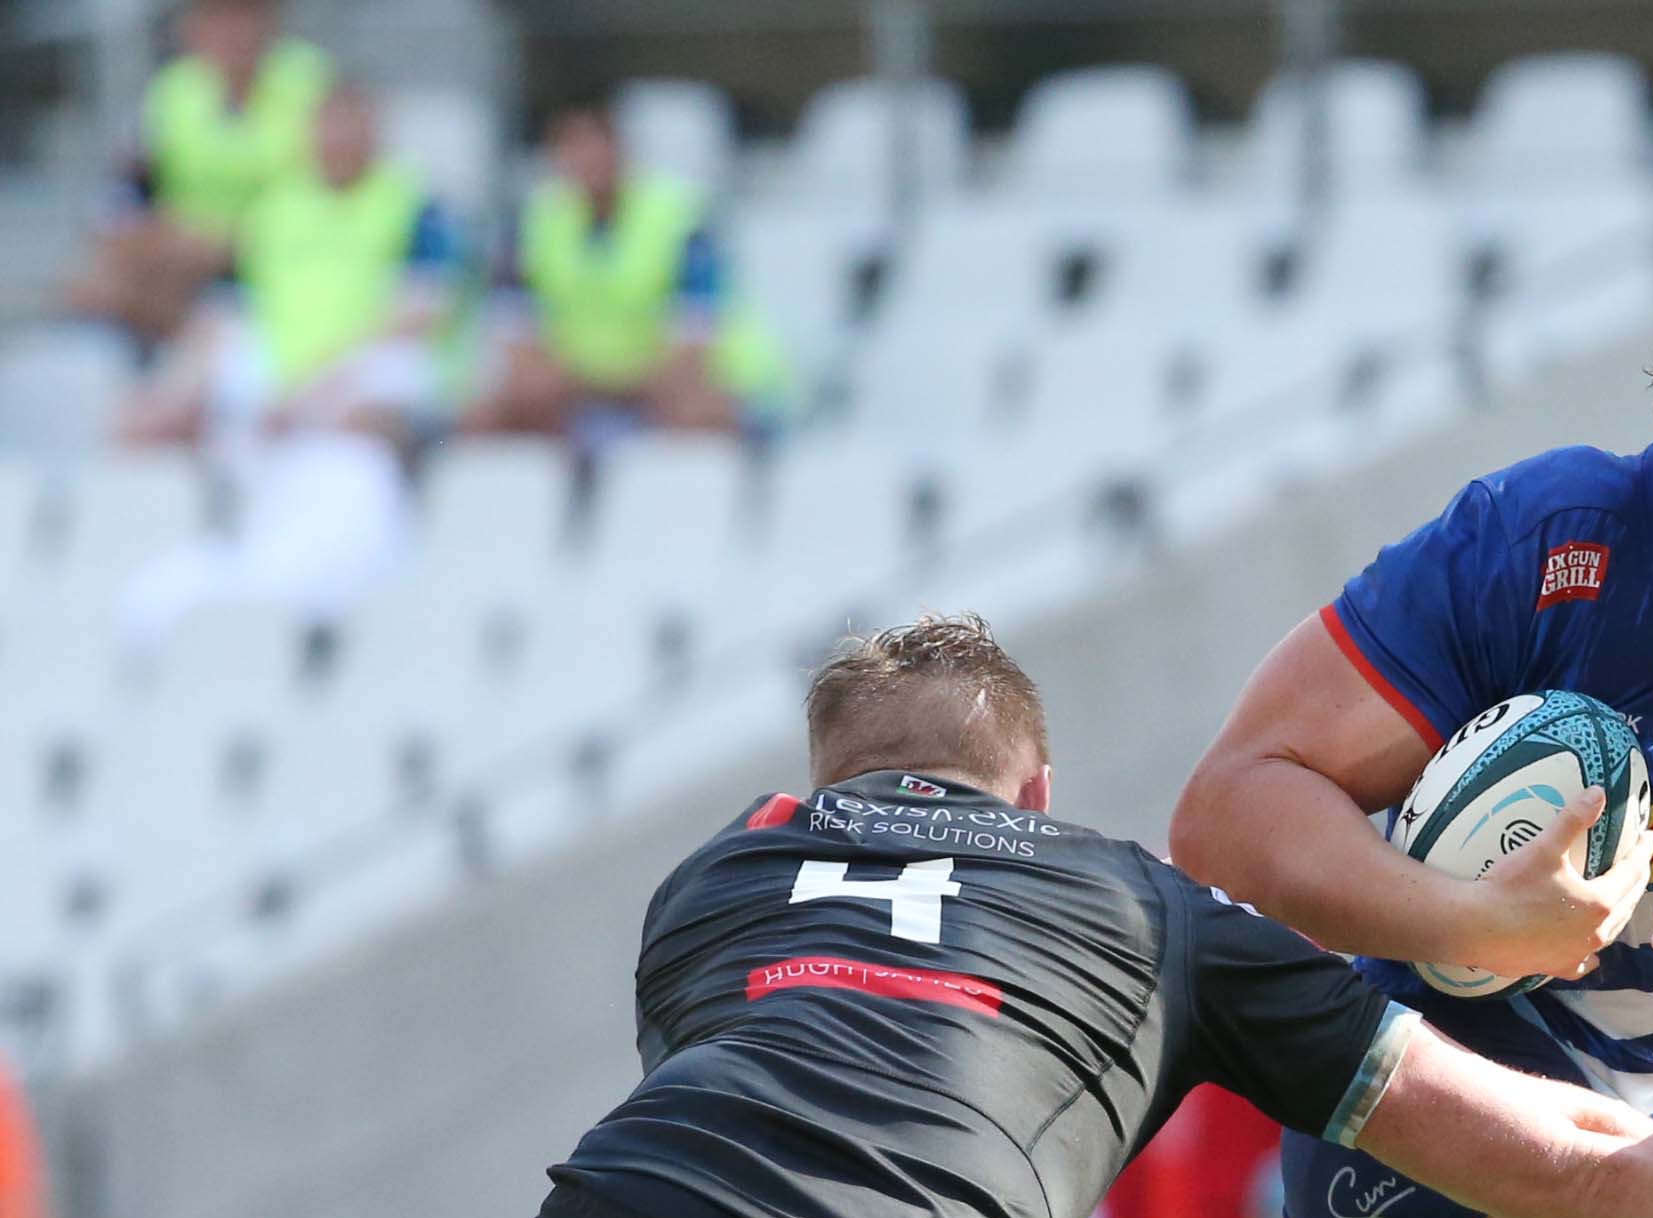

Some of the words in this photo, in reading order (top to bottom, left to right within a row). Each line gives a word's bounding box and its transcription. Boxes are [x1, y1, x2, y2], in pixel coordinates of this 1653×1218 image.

[1568, 551, 1601, 567] GUN
[1541, 567, 1600, 595] GRILL
[872, 822, 1035, 857] SOLUTIONS
[789, 857, 961, 943] 4
